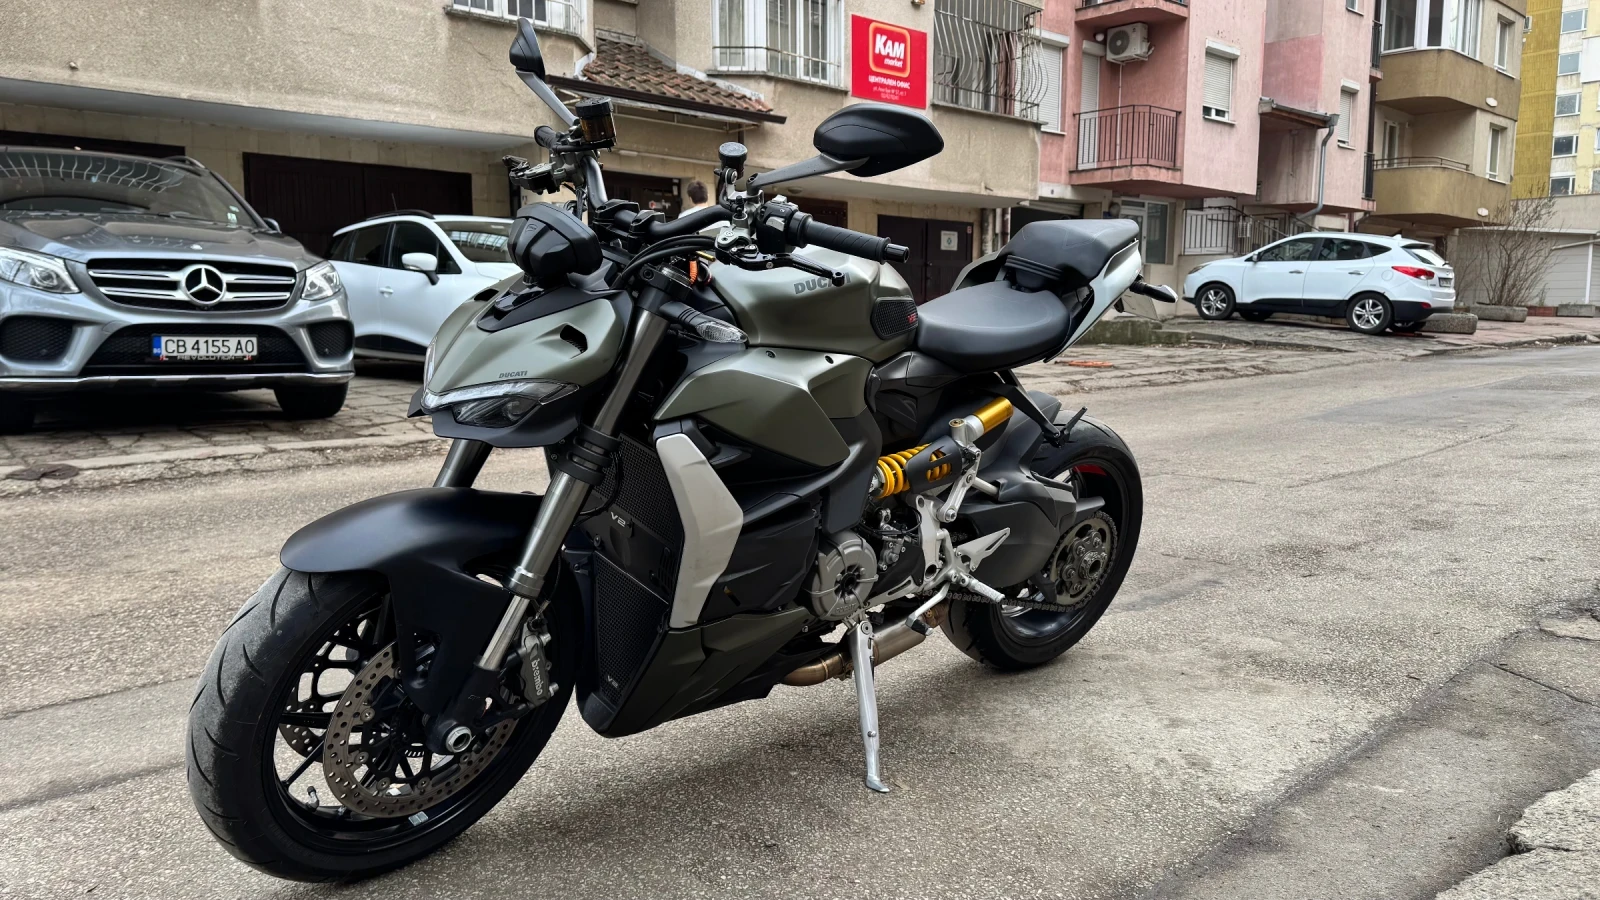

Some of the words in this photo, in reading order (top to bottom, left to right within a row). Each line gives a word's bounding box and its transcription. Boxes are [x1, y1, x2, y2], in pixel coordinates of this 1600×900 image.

[875, 33, 905, 60] KAM
[884, 58, 903, 68] market
[869, 75, 897, 86] ЦЕНТРАЛЕН
[897, 80, 910, 89] ОФИС
[794, 272, 851, 294] DUCI
[165, 339, 187, 354] CB
[192, 339, 230, 354] 4155
[499, 370, 528, 379] DUCATI
[611, 511, 626, 527] V2
[531, 658, 544, 696] brembo
